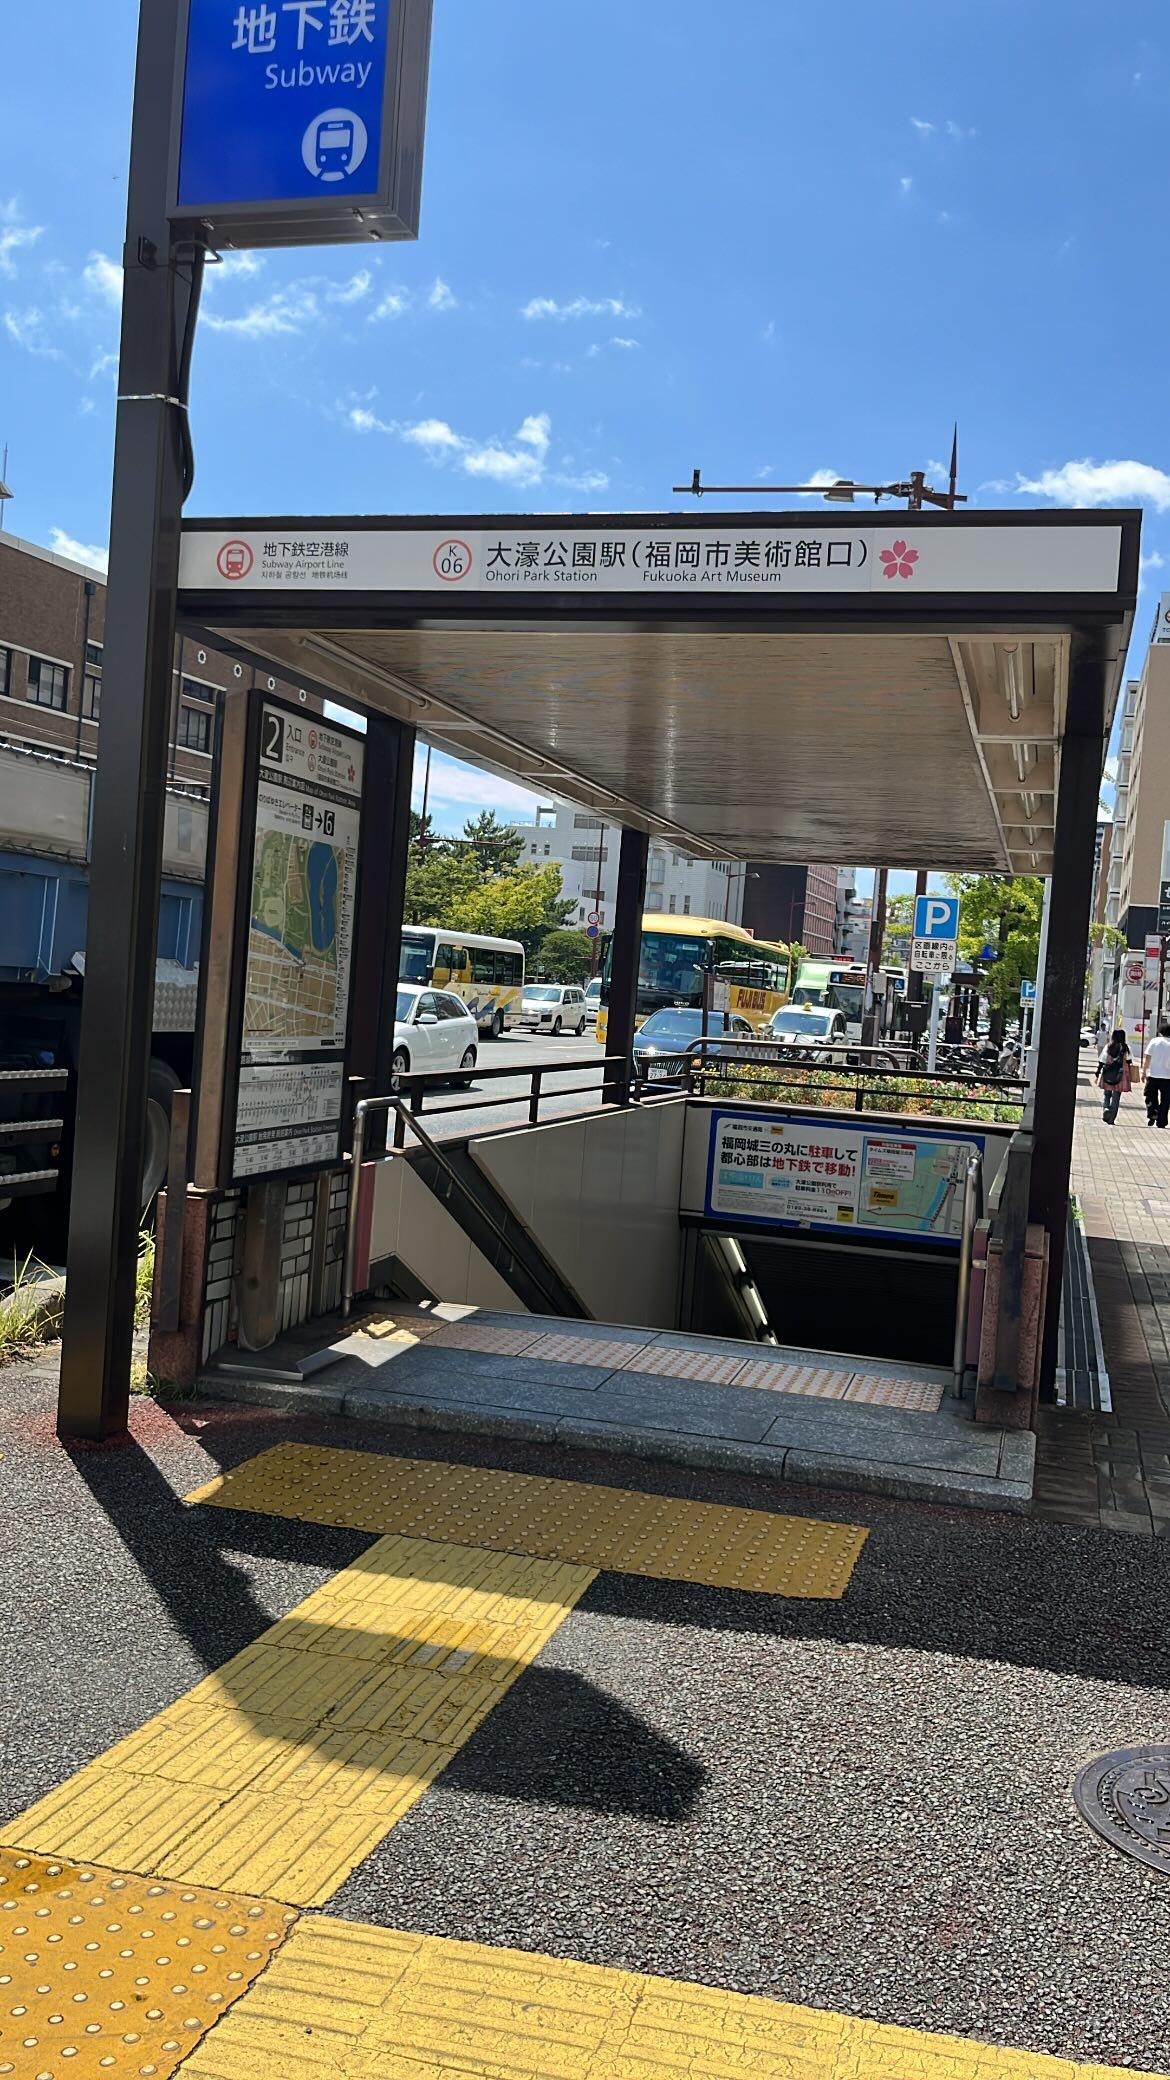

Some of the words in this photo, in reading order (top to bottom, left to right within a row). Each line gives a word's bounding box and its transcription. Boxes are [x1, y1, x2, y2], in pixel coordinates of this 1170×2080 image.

[231, 0, 376, 54] 地下鉄
[264, 59, 373, 90] Subway
[263, 541, 349, 558] 地下鉄空港線
[448, 544, 458, 557] K
[262, 560, 294, 571] Subway
[295, 560, 325, 571] Airport
[327, 560, 345, 569] Line
[441, 557, 464, 574] 06
[485, 570, 520, 582] Ohori
[523, 570, 550, 582] Park
[553, 570, 598, 582] Station
[643, 570, 697, 582] Fukuoka
[701, 570, 722, 582] Art
[726, 570, 782, 582] Museum
[265, 716, 281, 760] 2
[286, 723, 302, 744] 入口
[325, 812, 334, 836] 6
[925, 900, 952, 935] P
[914, 950, 954, 961] 自転車に限る
[915, 961, 950, 971] ここから
[752, 991, 767, 1010] BUS
[720, 1135, 859, 1162] 福岡城三の丸に駐車して
[719, 1151, 857, 1178] 都心部は地下鉄で移動!
